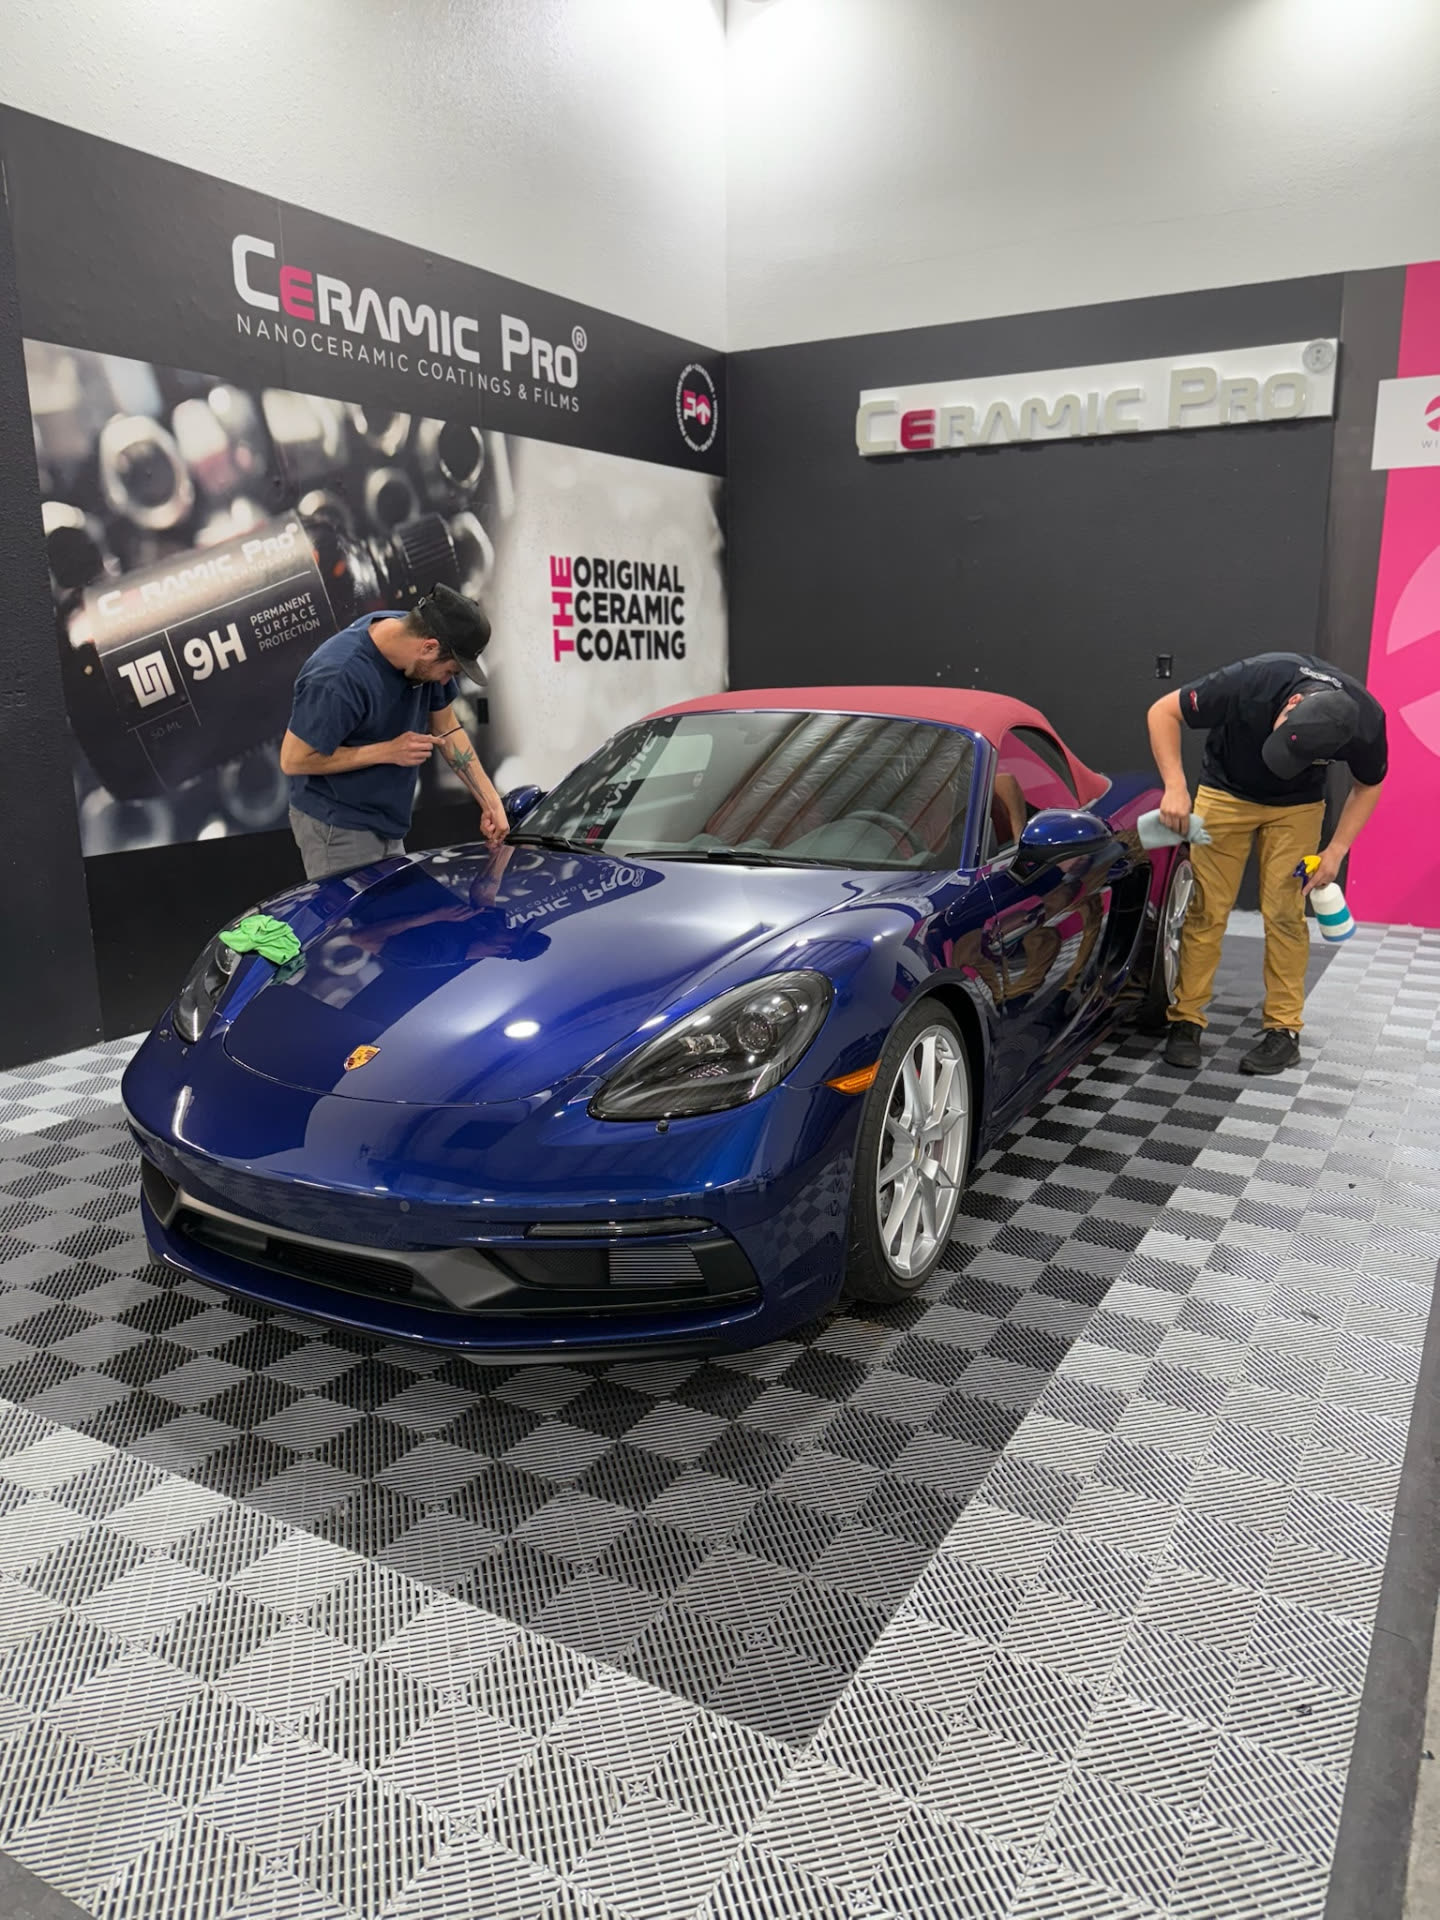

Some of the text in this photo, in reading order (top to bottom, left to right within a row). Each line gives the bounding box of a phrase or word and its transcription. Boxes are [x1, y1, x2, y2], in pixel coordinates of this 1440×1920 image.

[231, 234, 481, 364] CERAMIC
[236, 312, 580, 413] NANOCERAMIC COATINGS & FILMS
[856, 388, 1141, 455] CERAMIC
[573, 556, 685, 593] ORIGINAL
[250, 592, 312, 626] PERMANENT
[254, 605, 317, 639] SURFACE
[550, 555, 575, 662] THE
[574, 590, 686, 626] CERAMIC
[183, 622, 248, 681] 9H
[258, 618, 321, 652] PROTECTION
[576, 628, 686, 662] COATING
